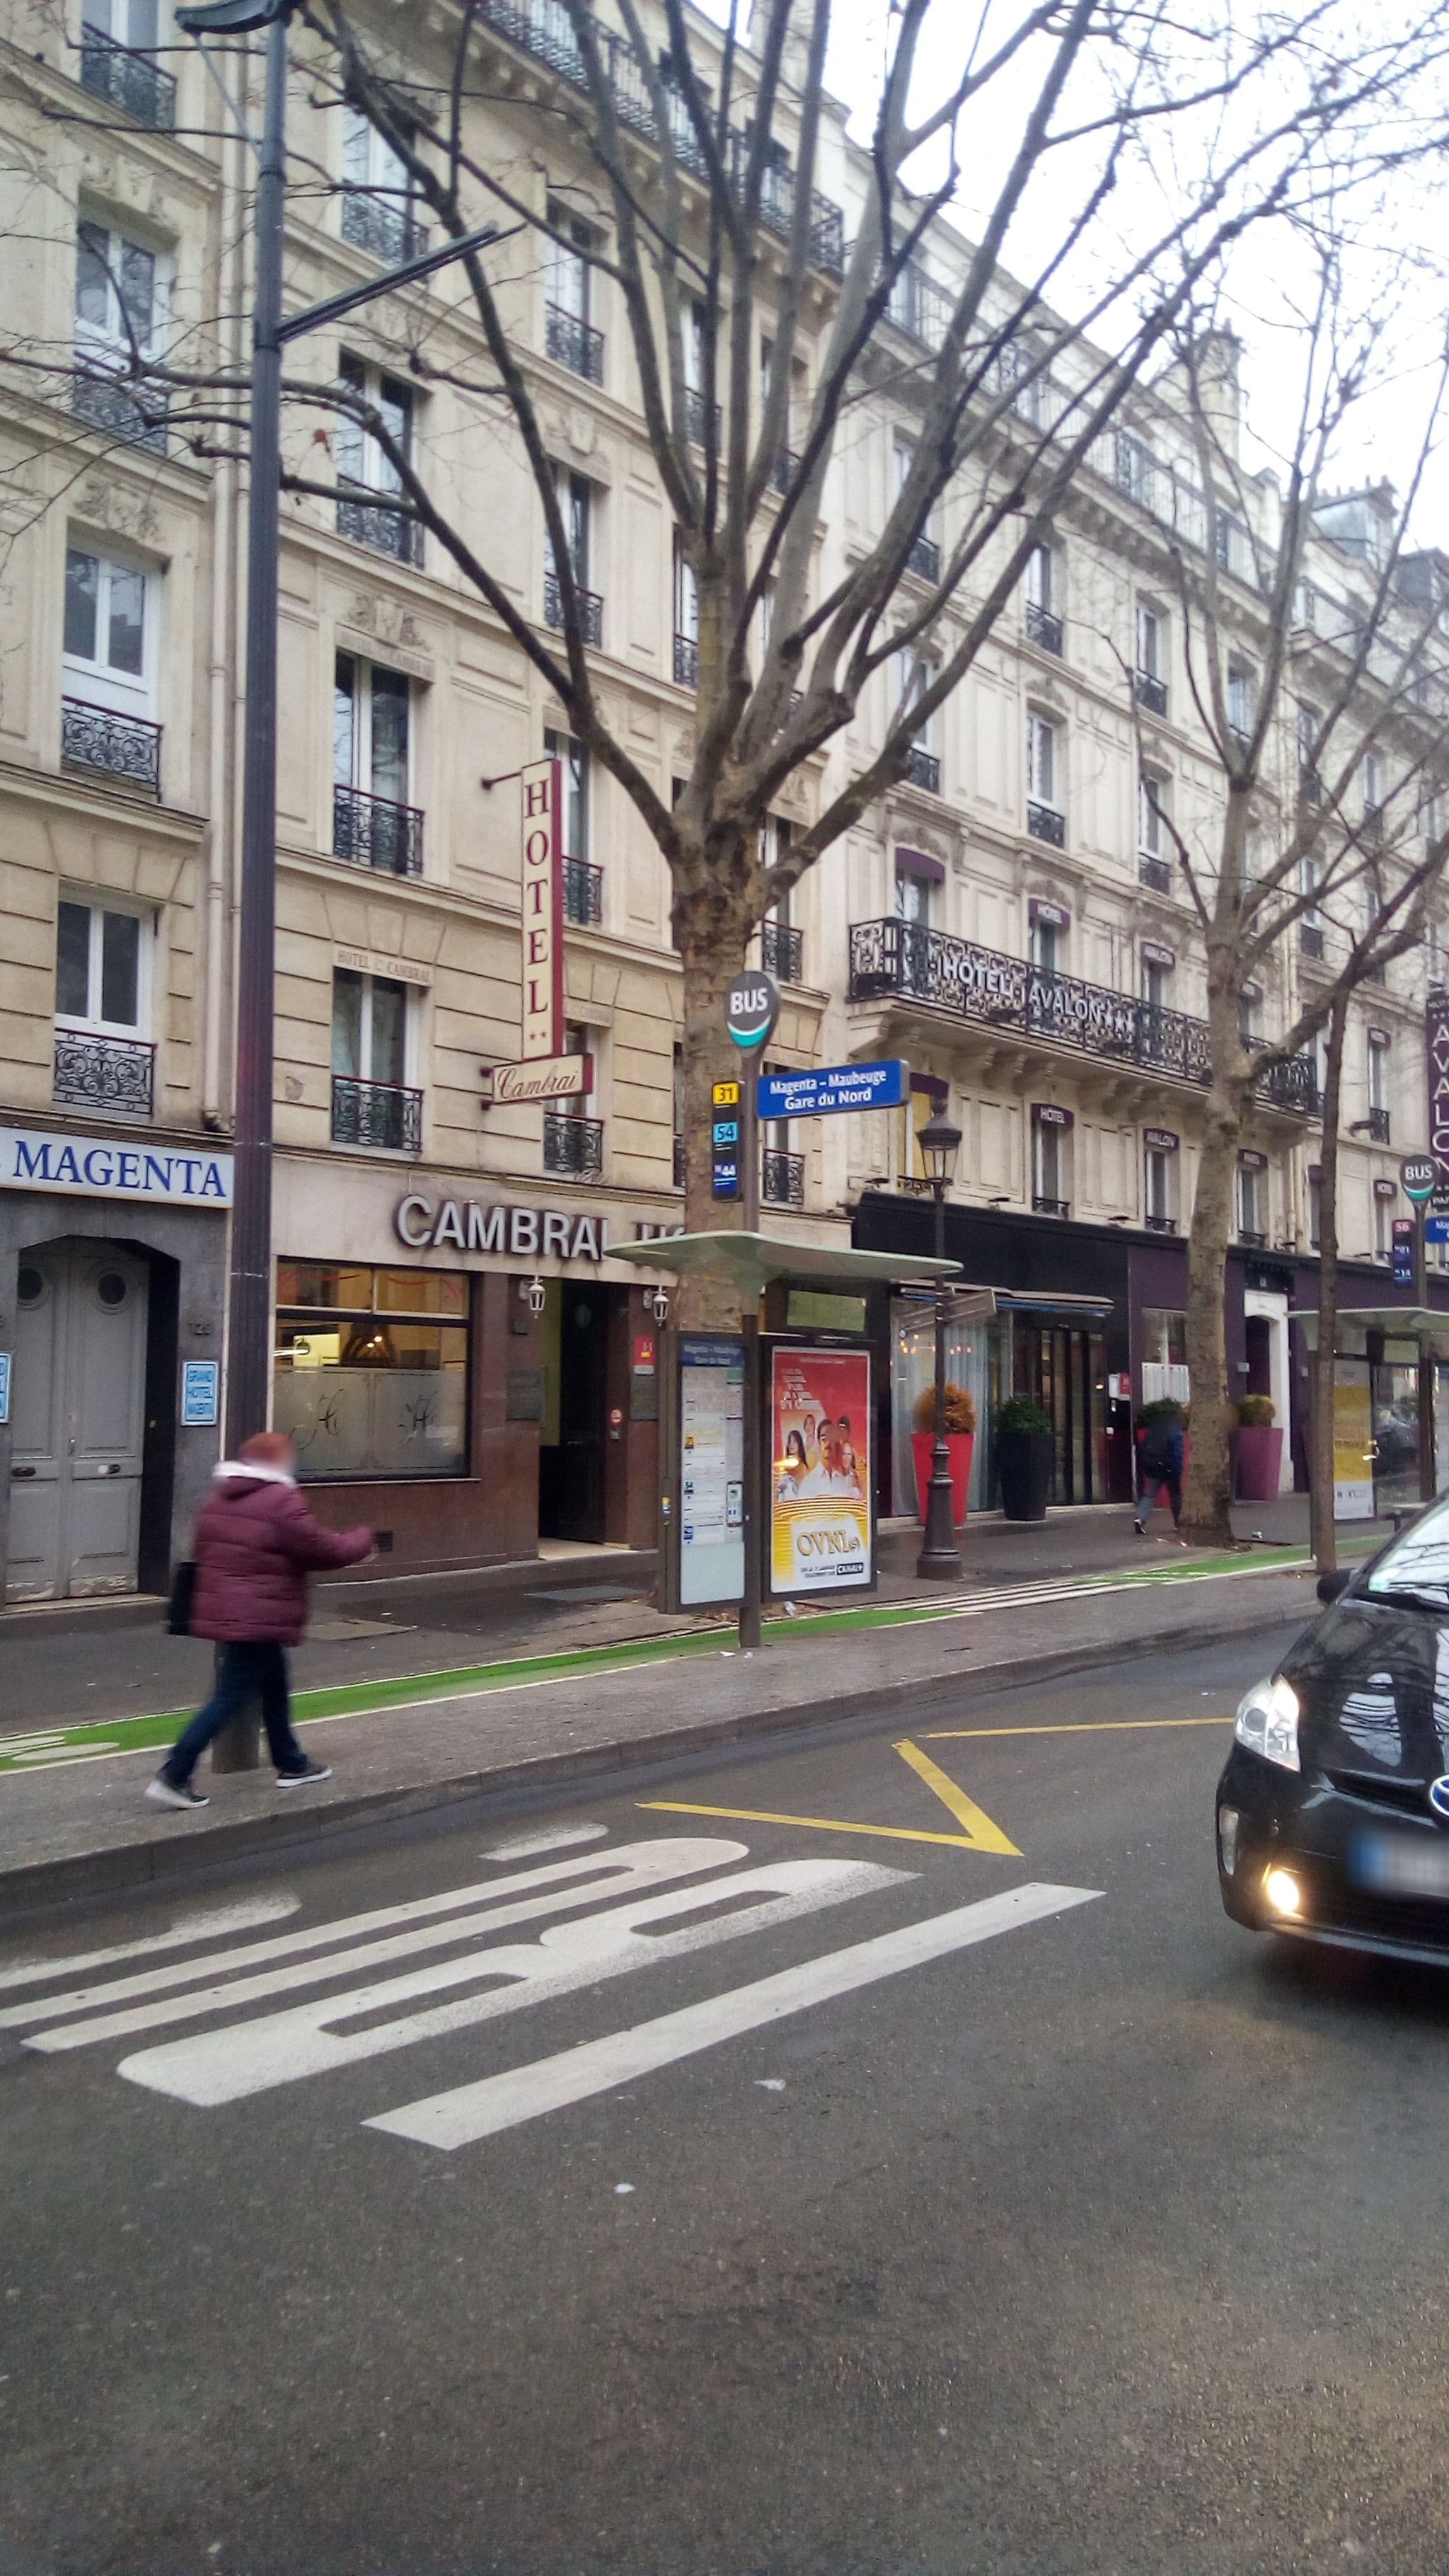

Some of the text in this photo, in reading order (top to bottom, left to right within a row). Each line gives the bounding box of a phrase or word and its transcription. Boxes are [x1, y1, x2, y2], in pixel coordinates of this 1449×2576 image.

[524, 778, 550, 1016] HOTEL
[729, 988, 768, 1016] BUS
[1028, 978, 1101, 1026] AVALON
[497, 1064, 579, 1099] Cambrai
[718, 1087, 733, 1102] 31
[770, 1077, 818, 1096] Magenta
[829, 1069, 887, 1088] Maubeuge
[784, 1087, 872, 1110] Gare du Nord
[716, 1125, 735, 1141] 54
[12, 1140, 227, 1197] MAGENTA
[1404, 1166, 1433, 1180] BUS
[396, 1194, 610, 1262] CAMBRAI
